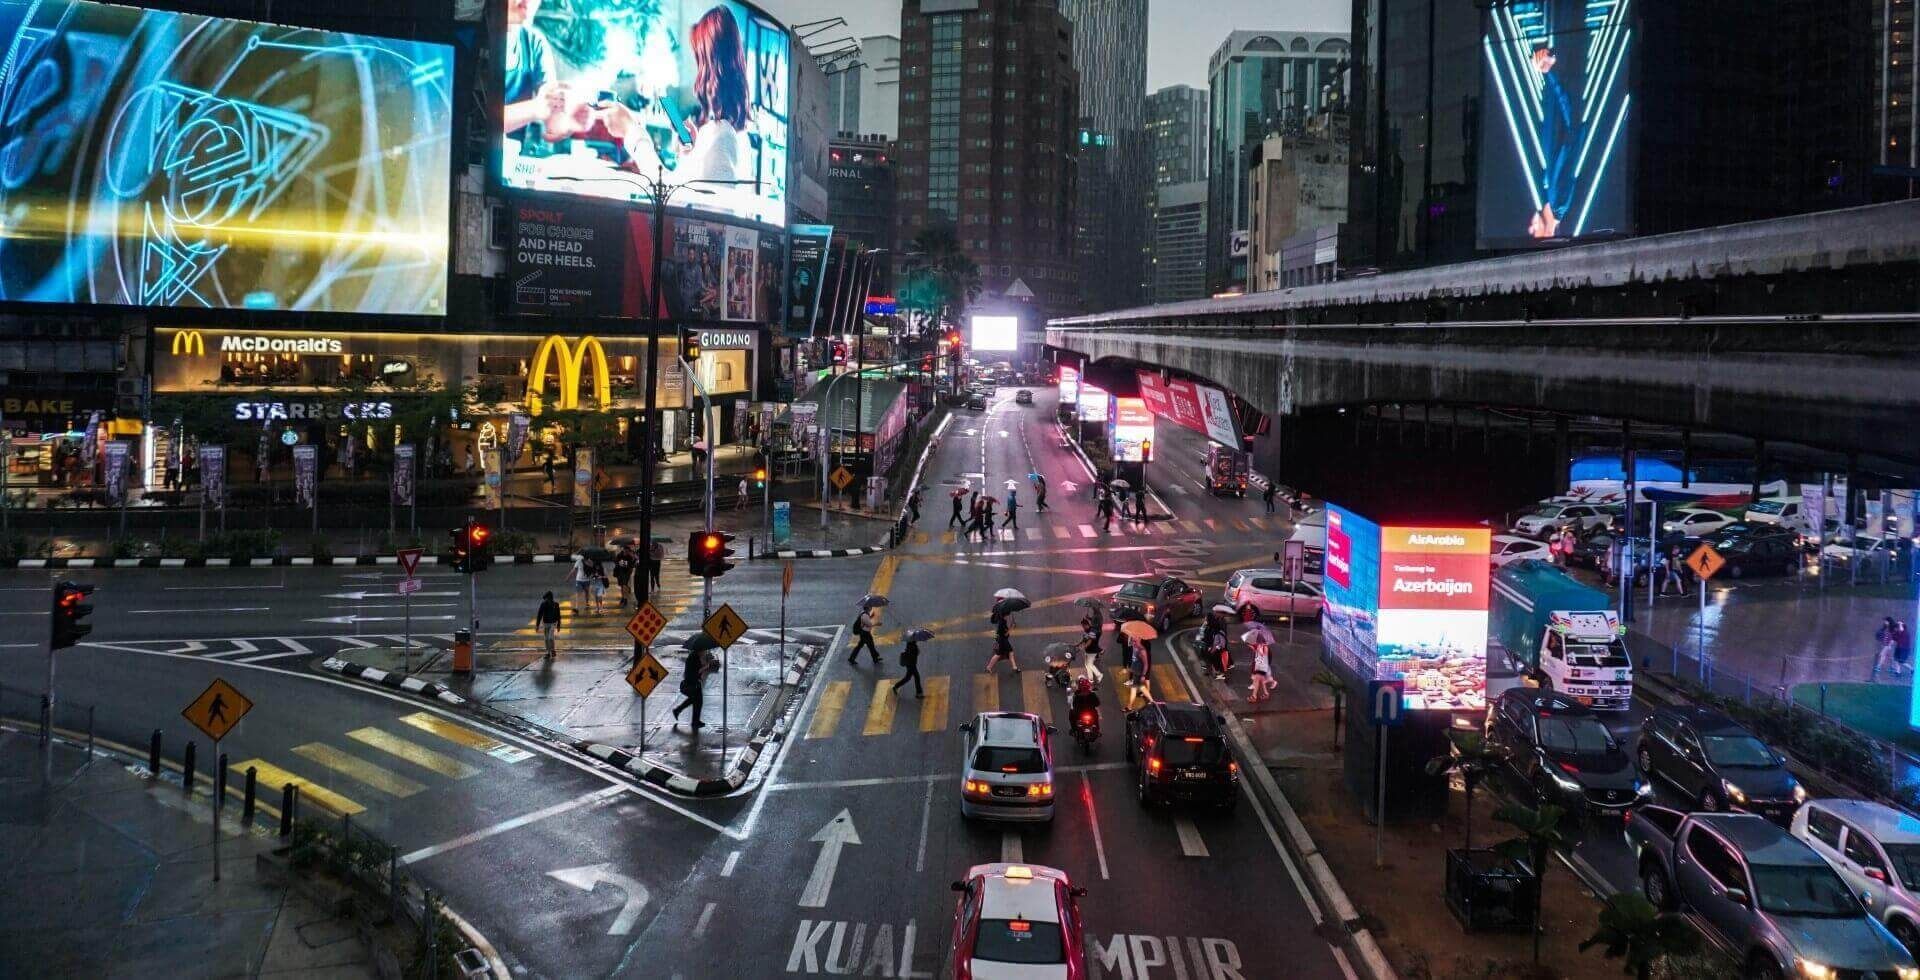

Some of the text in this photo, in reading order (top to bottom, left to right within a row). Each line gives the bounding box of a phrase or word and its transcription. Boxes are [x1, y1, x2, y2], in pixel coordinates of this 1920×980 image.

[519, 208, 564, 223] SPOILT
[519, 222, 594, 241] FOR CHOICE
[518, 238, 583, 253] AND HEAD
[518, 252, 596, 268] OVER HEELS.
[221, 335, 342, 353] McDonald's
[701, 332, 750, 347] GIORDANO
[4, 398, 74, 414] BAKE
[1407, 534, 1465, 546] AirArabia
[1392, 577, 1473, 597] Azerbaijan
